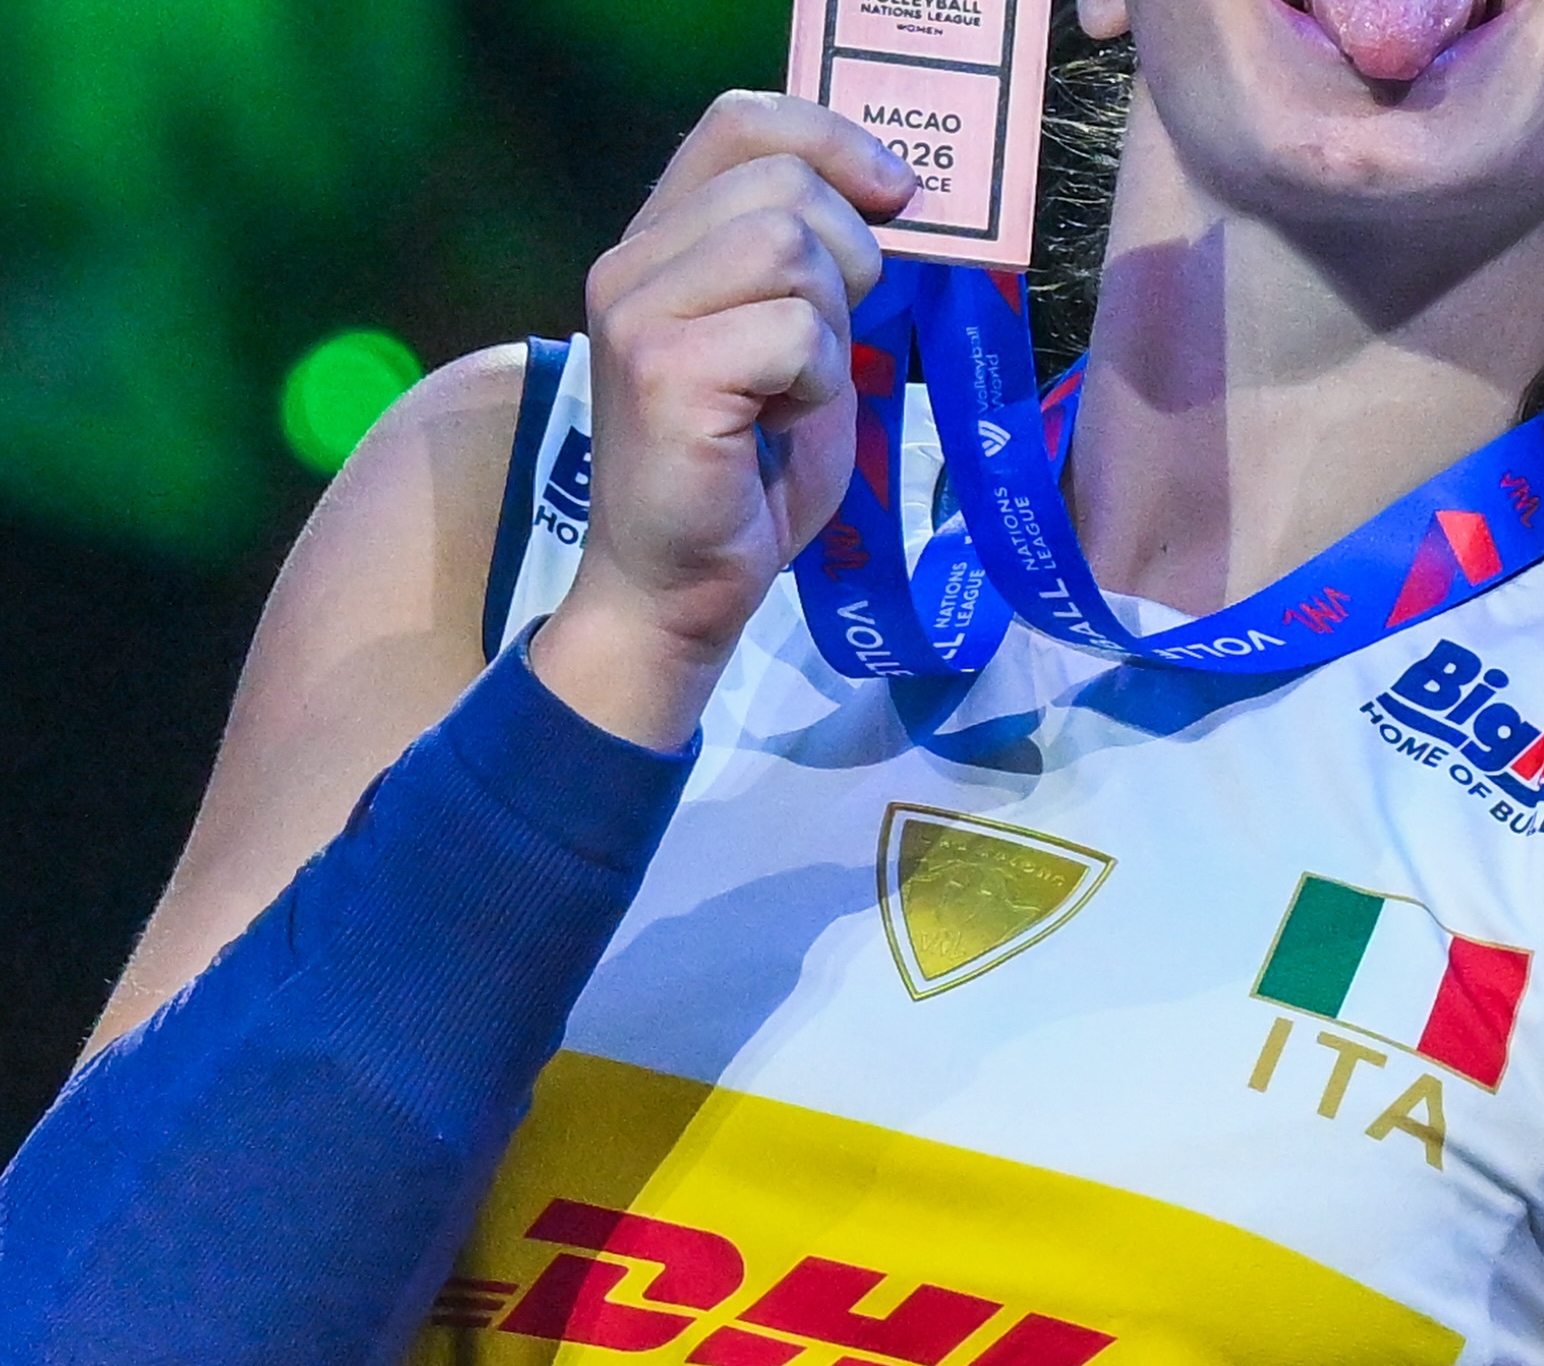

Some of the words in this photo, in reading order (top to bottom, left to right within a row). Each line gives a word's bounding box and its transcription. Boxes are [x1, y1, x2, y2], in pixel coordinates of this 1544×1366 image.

[860, 2, 922, 20] NATIONS
[927, 11, 981, 27] LEAGUE
[863, 104, 961, 133] MACAO
[883, 138, 954, 169] 026
[915, 175, 952, 193] ACE
[966, 326, 989, 414] Volleyball
[985, 353, 1005, 413] World
[994, 486, 1040, 571] NATIONS
[1015, 496, 1057, 570] LEAGUE
[933, 562, 967, 628] NATIONS
[954, 569, 985, 628] LEAGUE
[1360, 701, 1449, 767] HOME
[1449, 764, 1492, 799] OF
[1248, 1016, 1447, 1171] ITA
